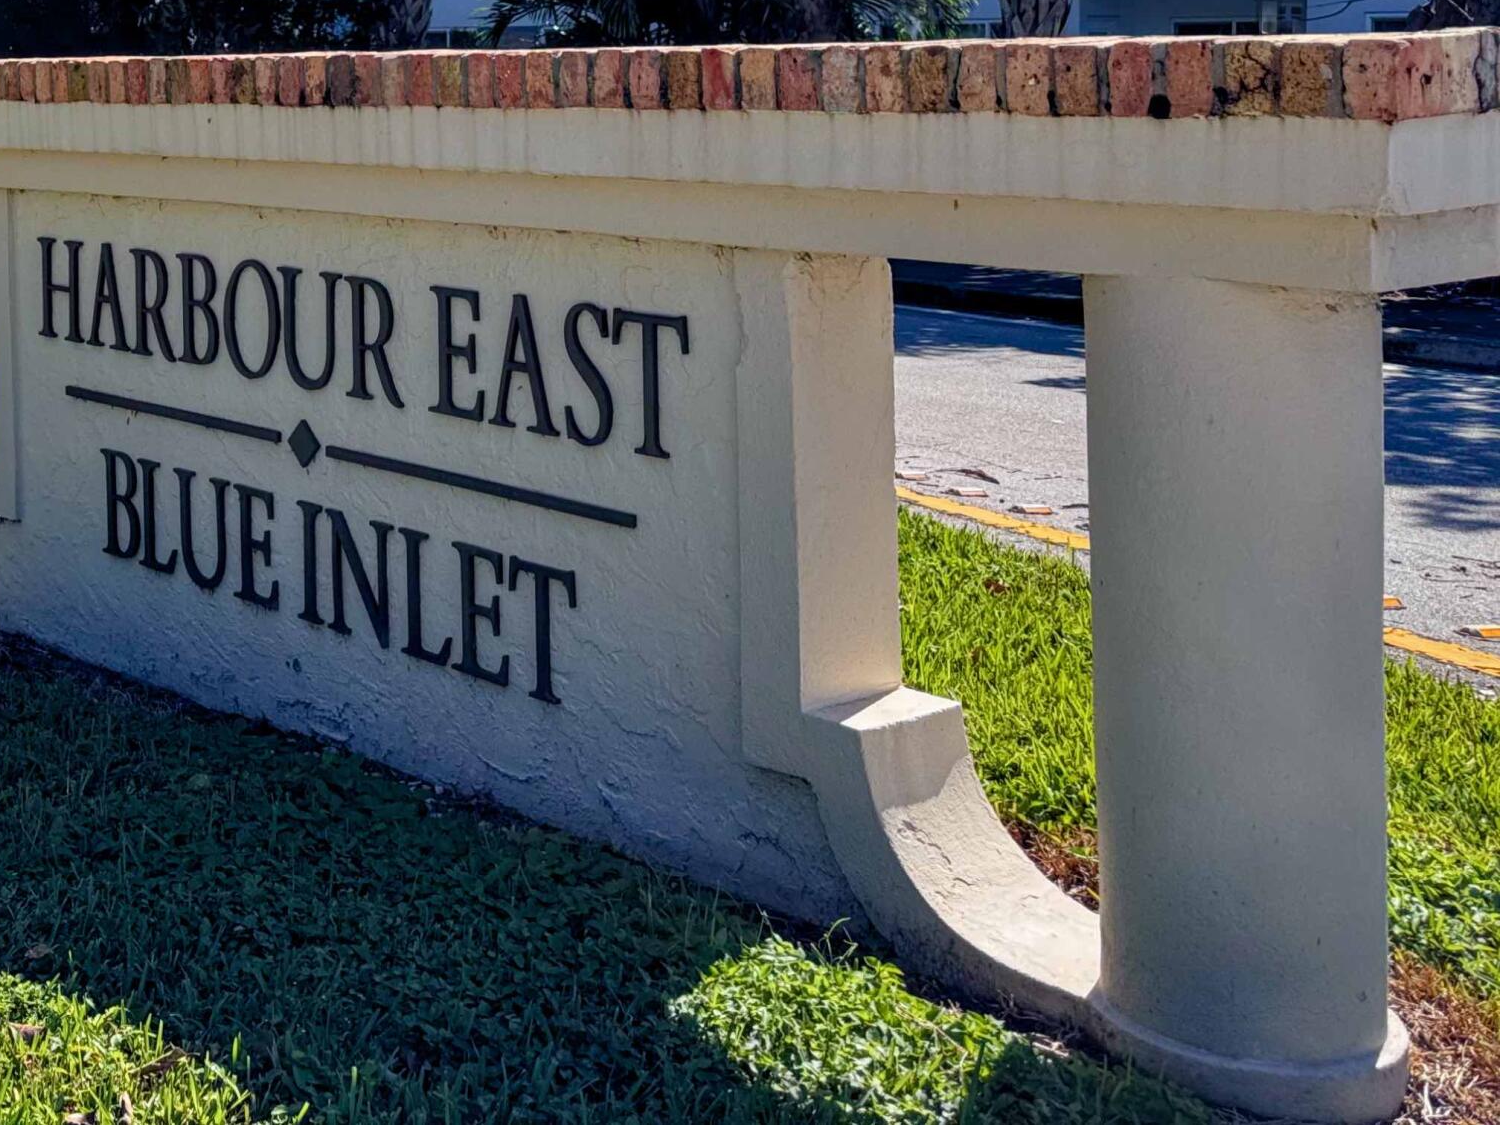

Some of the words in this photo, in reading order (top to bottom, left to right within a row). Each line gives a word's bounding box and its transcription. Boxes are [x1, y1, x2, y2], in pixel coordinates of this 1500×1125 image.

[37, 236, 405, 409] HARBOUR
[428, 285, 690, 459] EAST
[100, 447, 280, 611] BLUE
[296, 499, 578, 705] INLET
